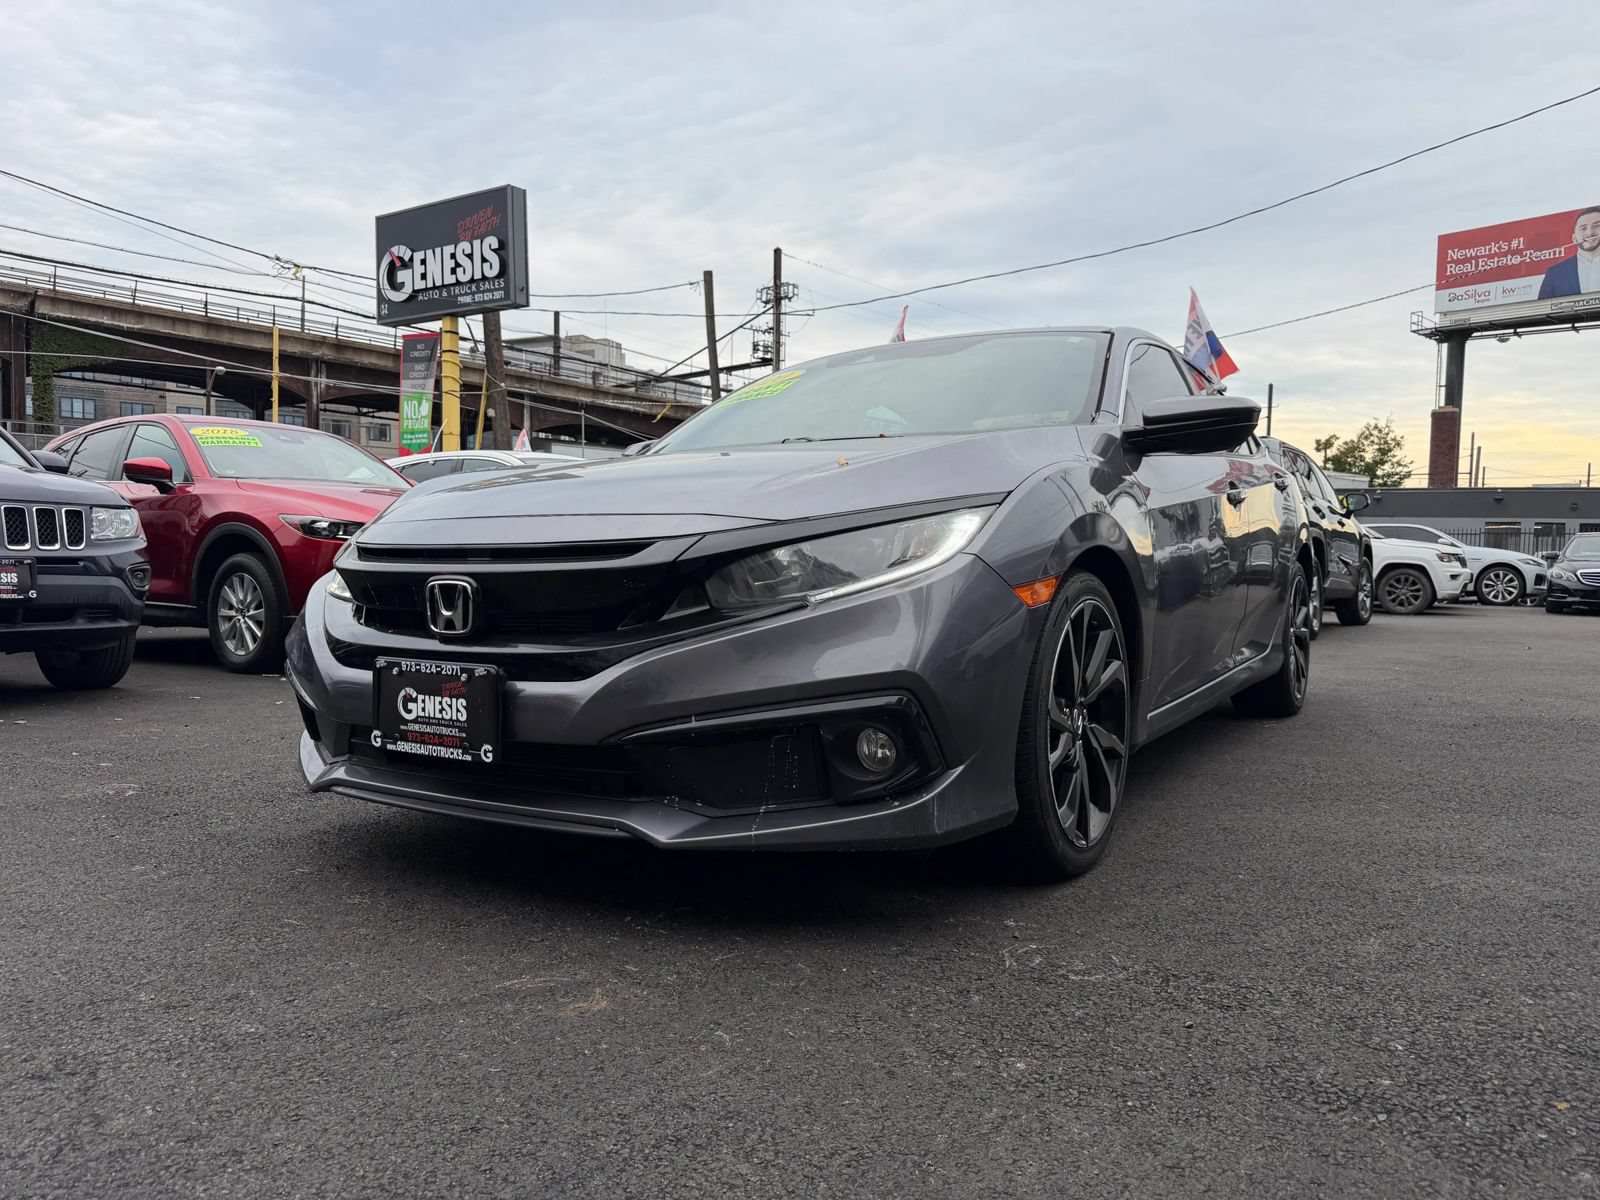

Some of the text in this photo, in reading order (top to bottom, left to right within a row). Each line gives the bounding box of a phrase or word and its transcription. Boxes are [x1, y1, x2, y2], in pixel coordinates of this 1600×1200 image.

[1447, 236, 1525, 261] Newark's #1
[379, 235, 500, 302] GENESIS
[1445, 245, 1566, 276] Real Estate Team
[418, 278, 505, 301] AUTO & TRUCK SALES
[1501, 285, 1518, 296] kw
[401, 661, 461, 676] 973-624-2071
[397, 686, 468, 722] GENESIS
[386, 740, 473, 762] www.GENESISAUTOTRUCKS.com
[407, 731, 461, 748] 973-624-2071
